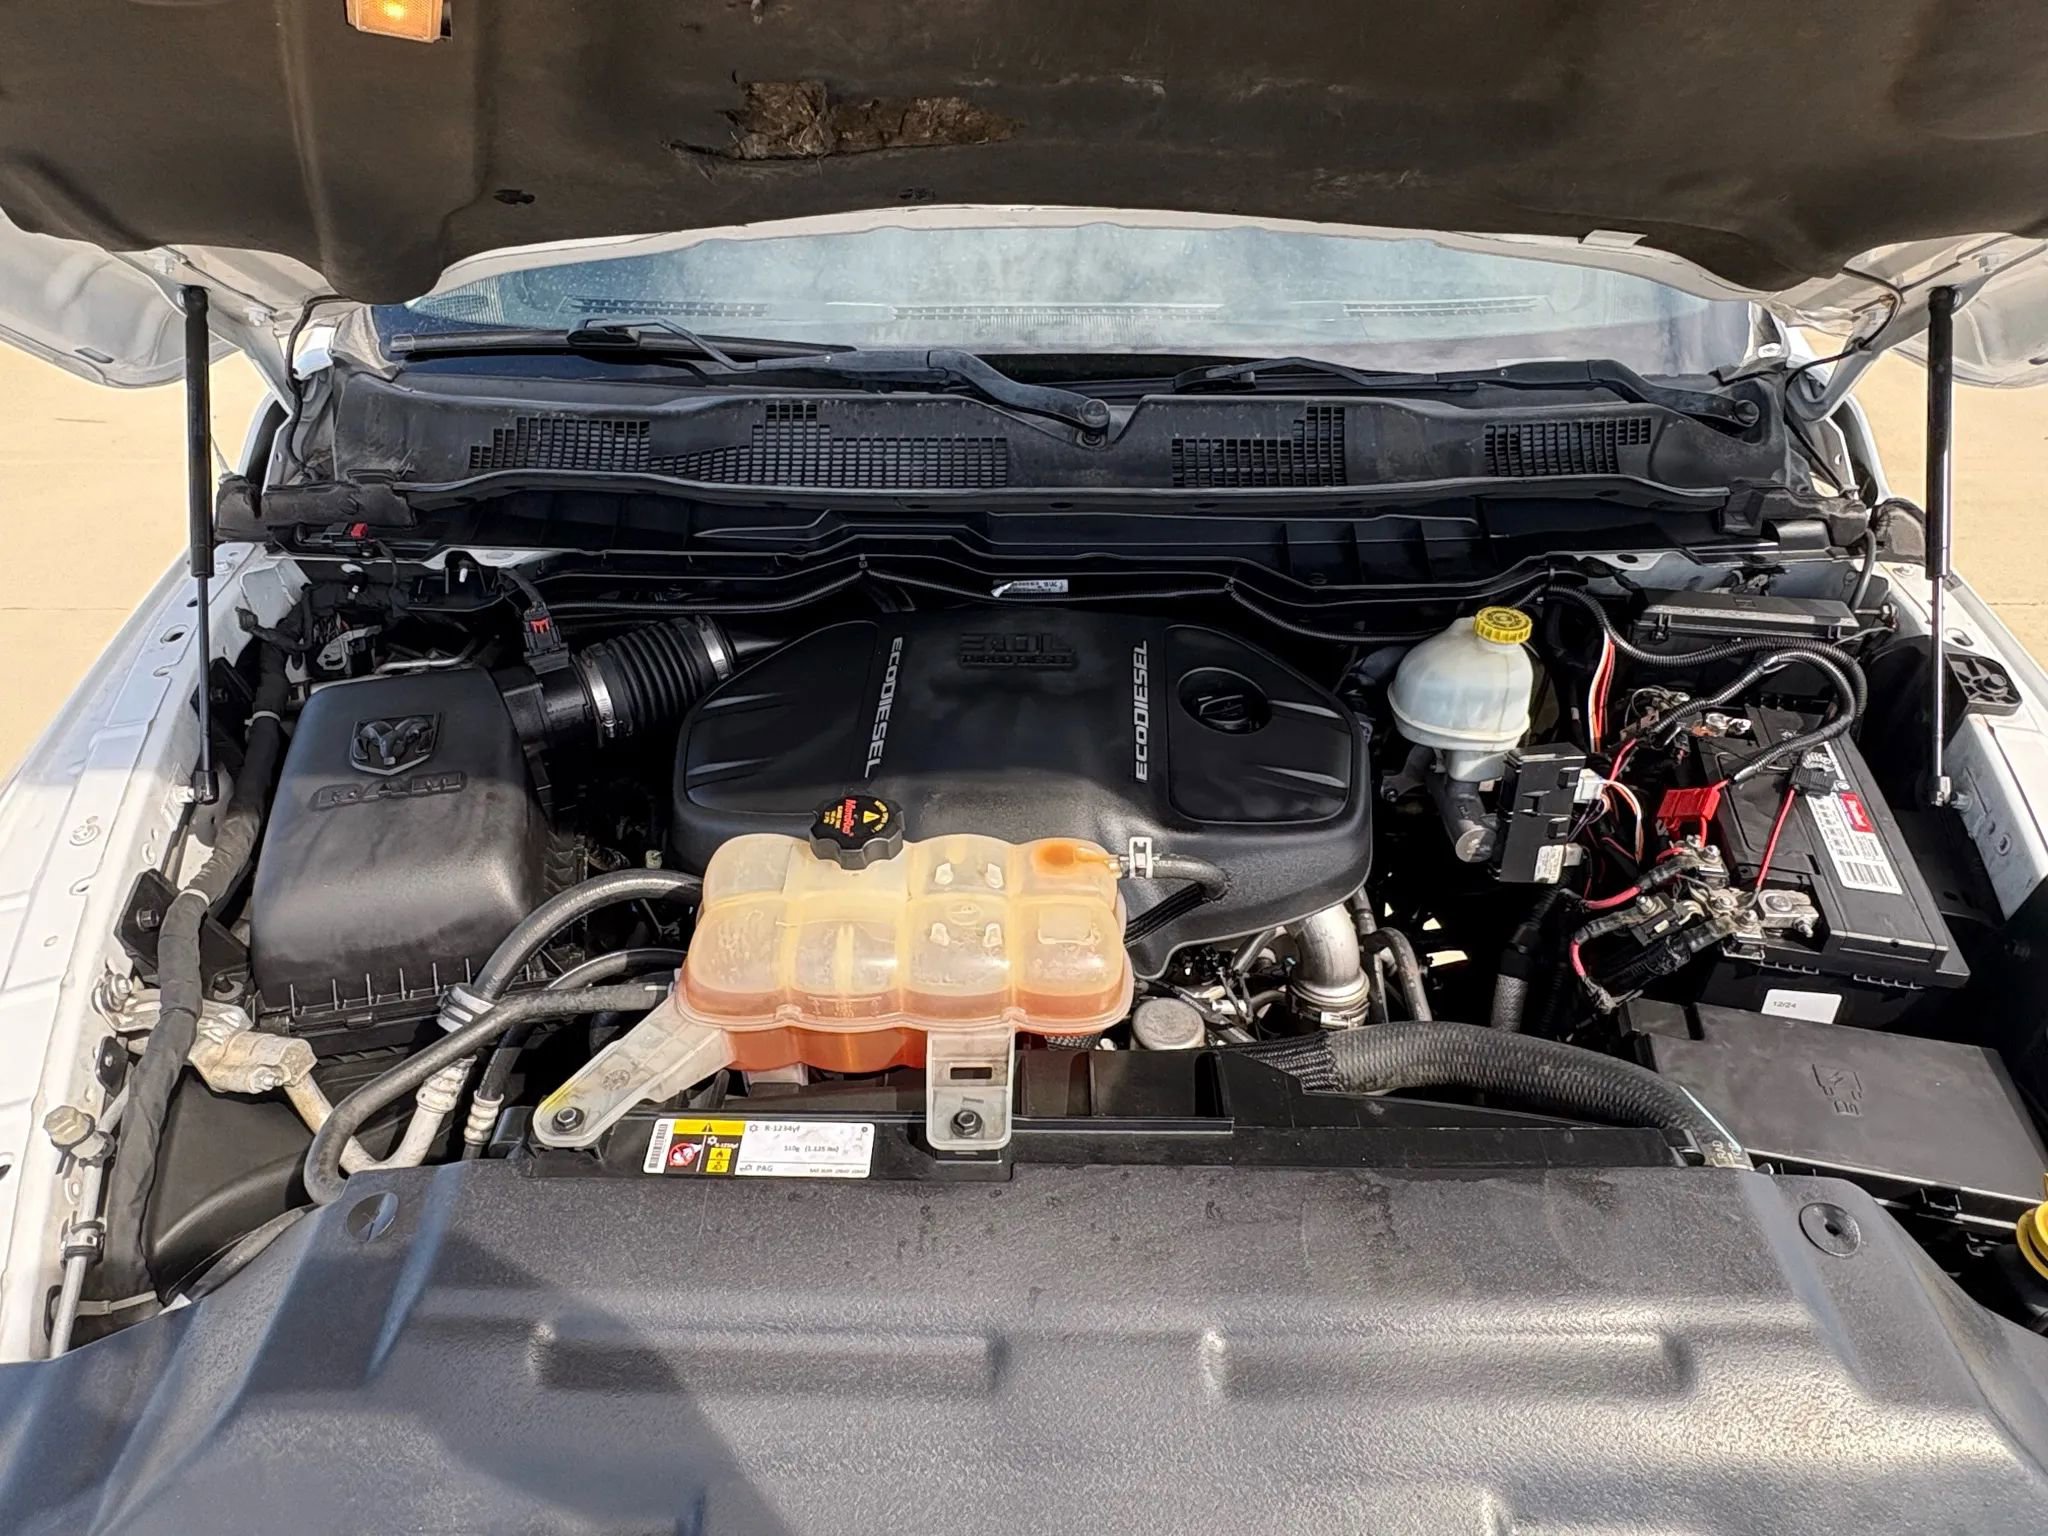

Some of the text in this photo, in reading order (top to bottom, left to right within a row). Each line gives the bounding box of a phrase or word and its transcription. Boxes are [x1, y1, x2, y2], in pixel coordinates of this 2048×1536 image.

[864, 636, 904, 779] ECODIESEL
[1133, 639, 1149, 781] ECODIESEL
[316, 773, 464, 806] RAM
[1773, 1001, 1797, 1009] 12/24
[764, 1124, 801, 1134] R-1234yf
[756, 1164, 774, 1173] PAG
